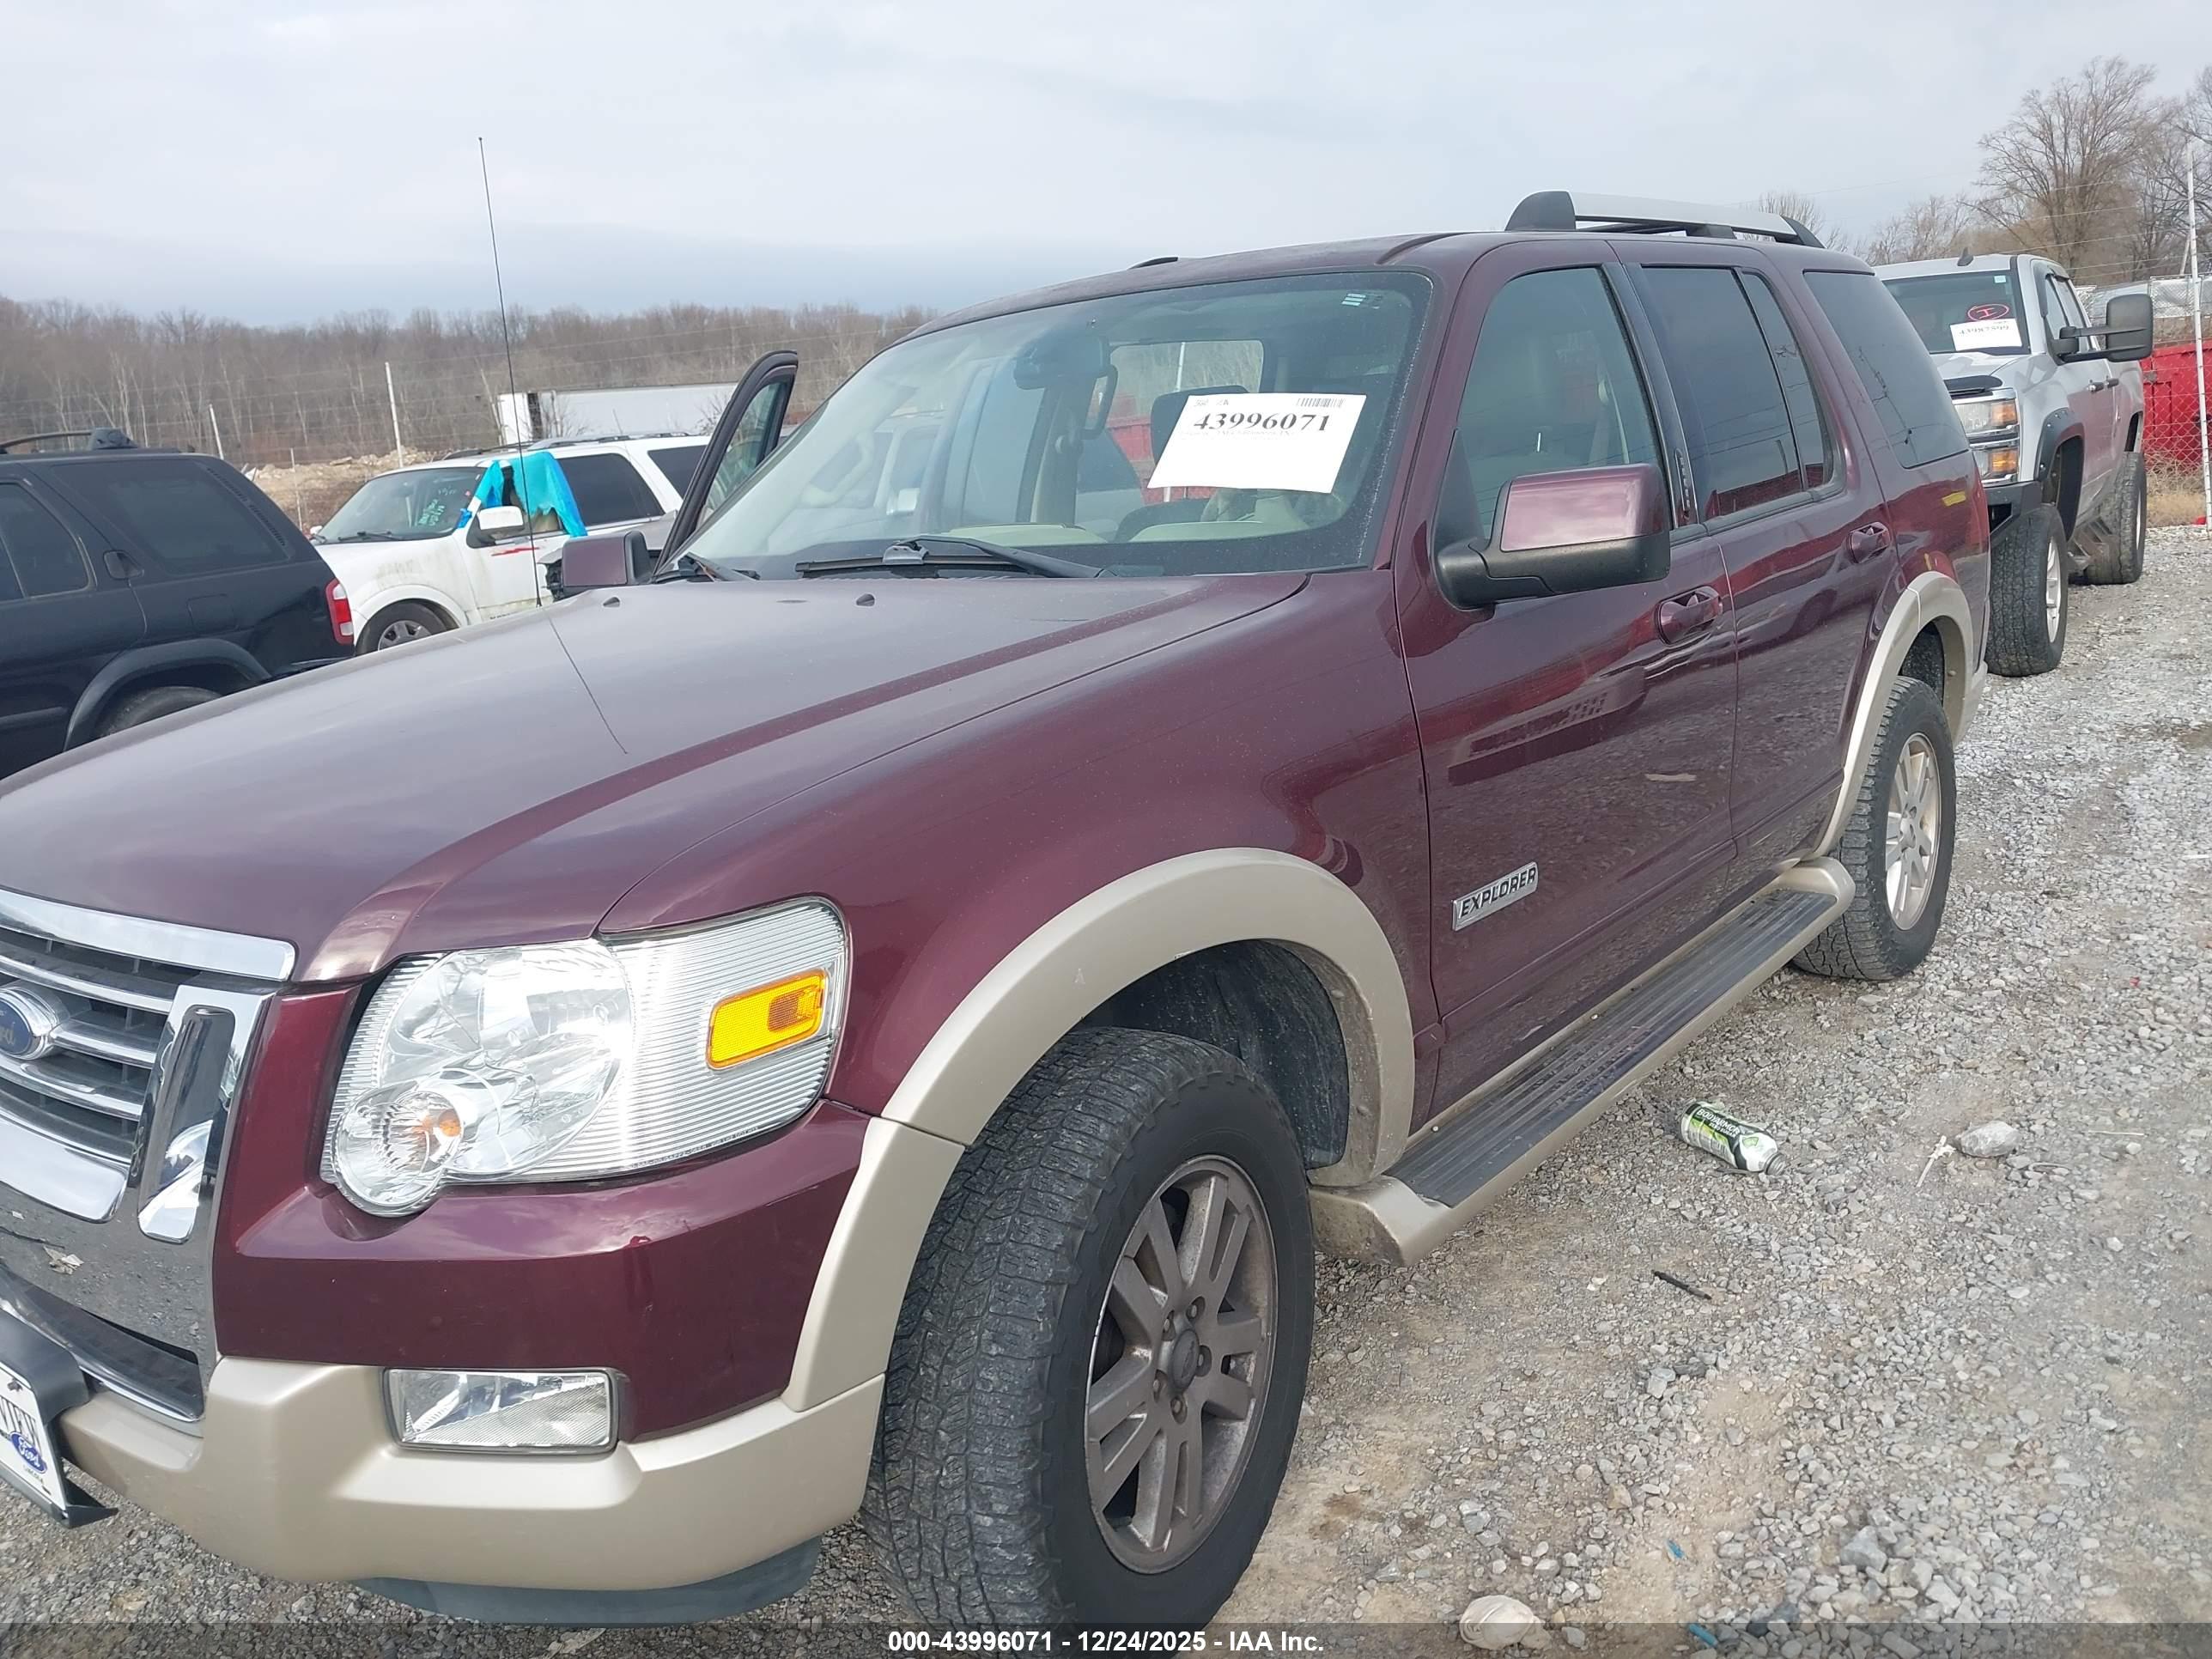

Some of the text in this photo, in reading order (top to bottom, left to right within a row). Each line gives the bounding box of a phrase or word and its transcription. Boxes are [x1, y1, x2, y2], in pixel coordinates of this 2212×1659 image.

[1194, 412, 1331, 431] 43996071
[1459, 867, 1536, 918] EXPLORER
[1696, 1108, 1741, 1135] BODYARMOR
[17, 1435, 41, 1468] Ford
